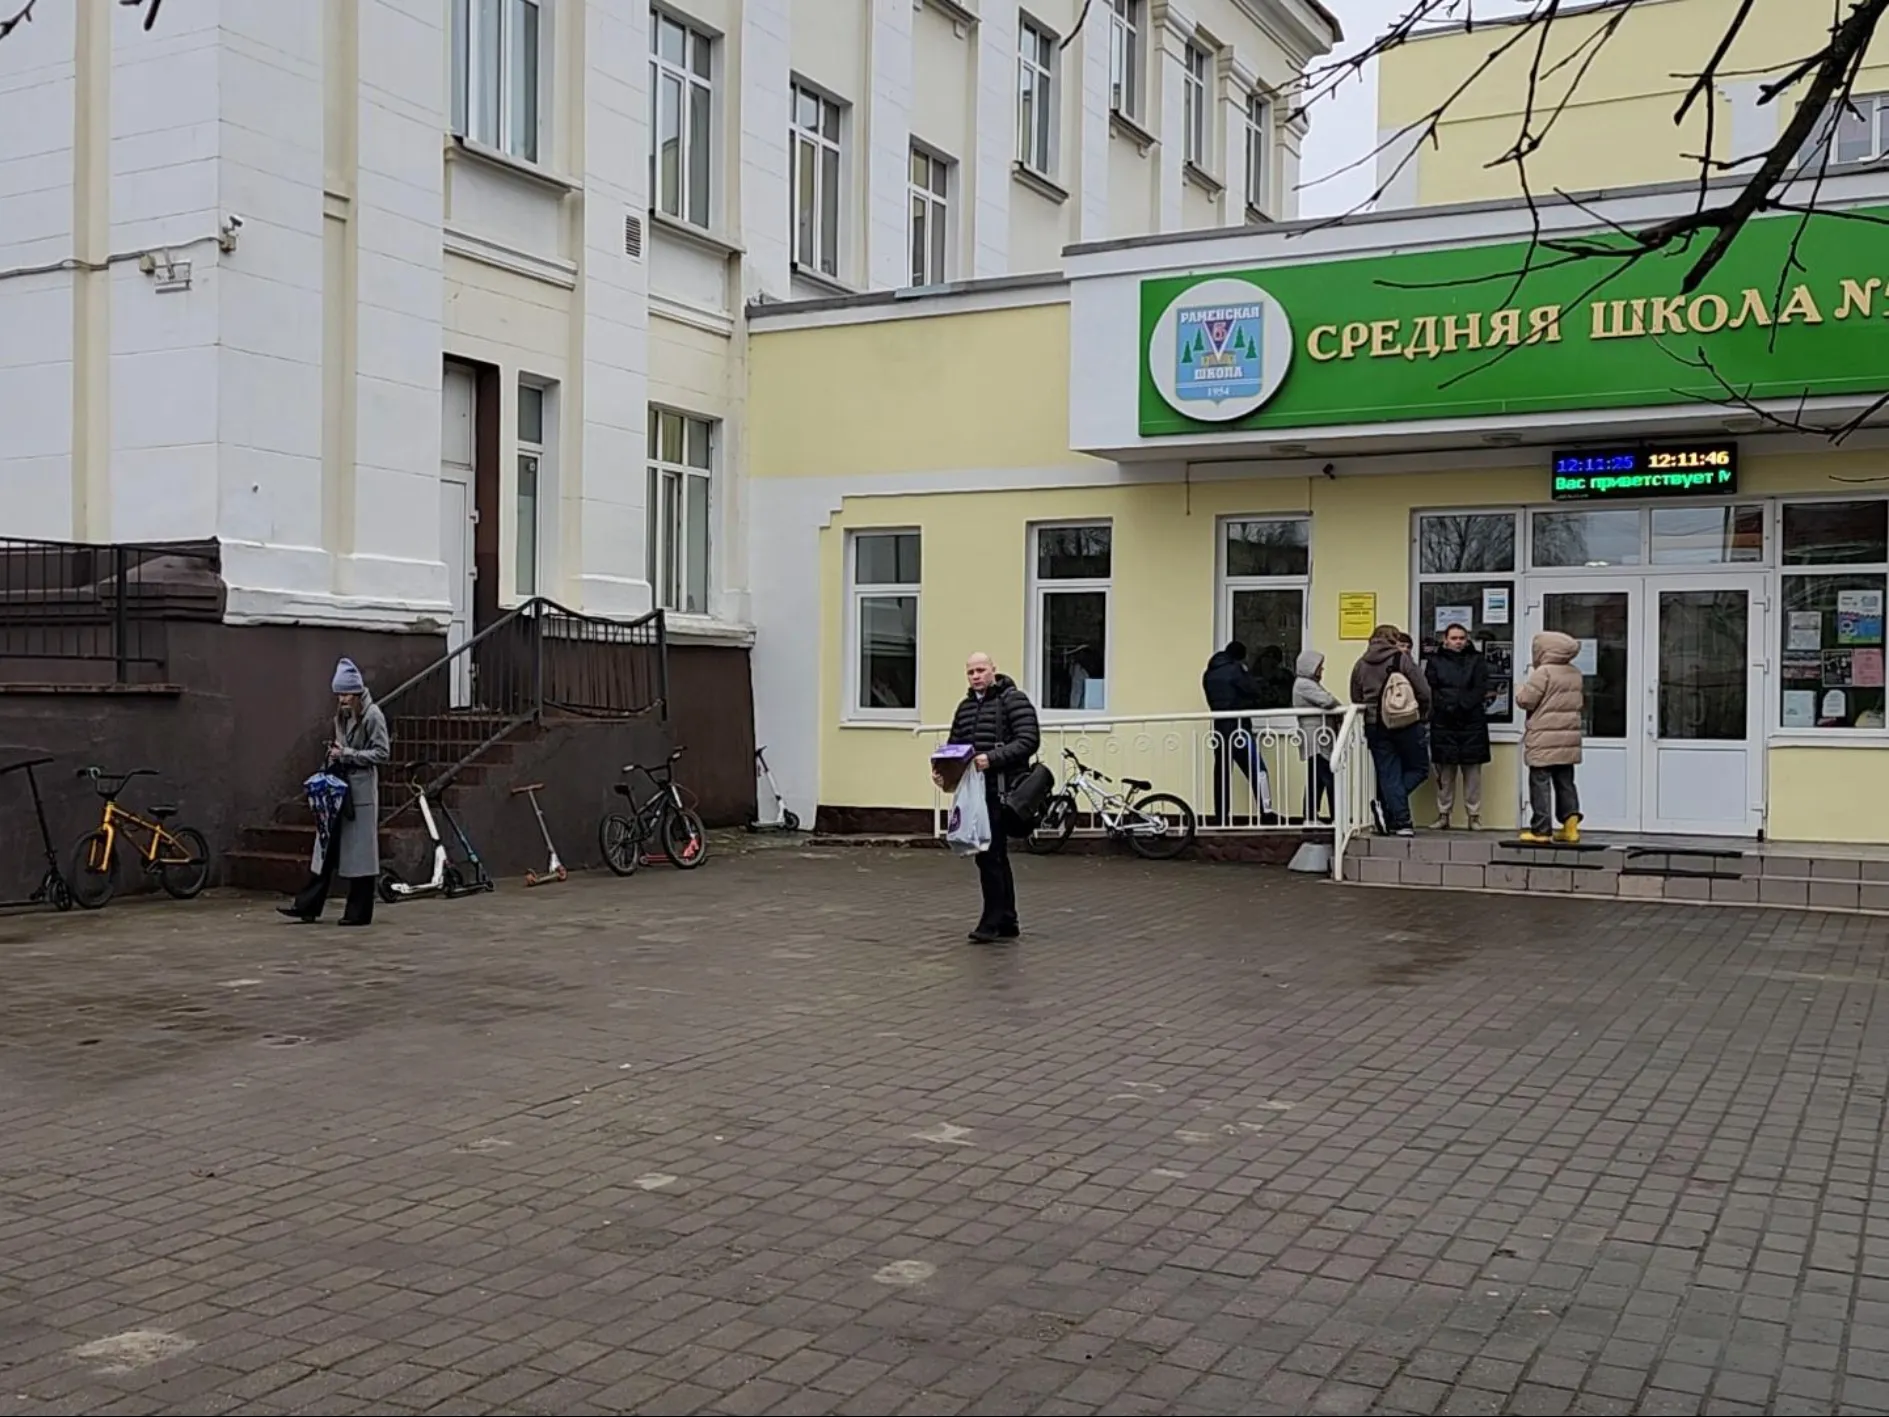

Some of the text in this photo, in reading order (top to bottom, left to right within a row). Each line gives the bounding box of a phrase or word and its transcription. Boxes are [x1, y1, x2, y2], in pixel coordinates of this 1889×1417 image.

[1180, 306, 1260, 323] РАМЕНСКАЯ
[1307, 304, 1561, 361] СРЕДНЯЯ
[1590, 284, 1823, 339] ШКОЛА
[1194, 366, 1243, 380] ШКОЛА
[1207, 386, 1230, 397] 1954
[1648, 451, 1730, 469] 12:11:46
[1555, 476, 1586, 490] Вас
[1590, 471, 1714, 492] приветствует
